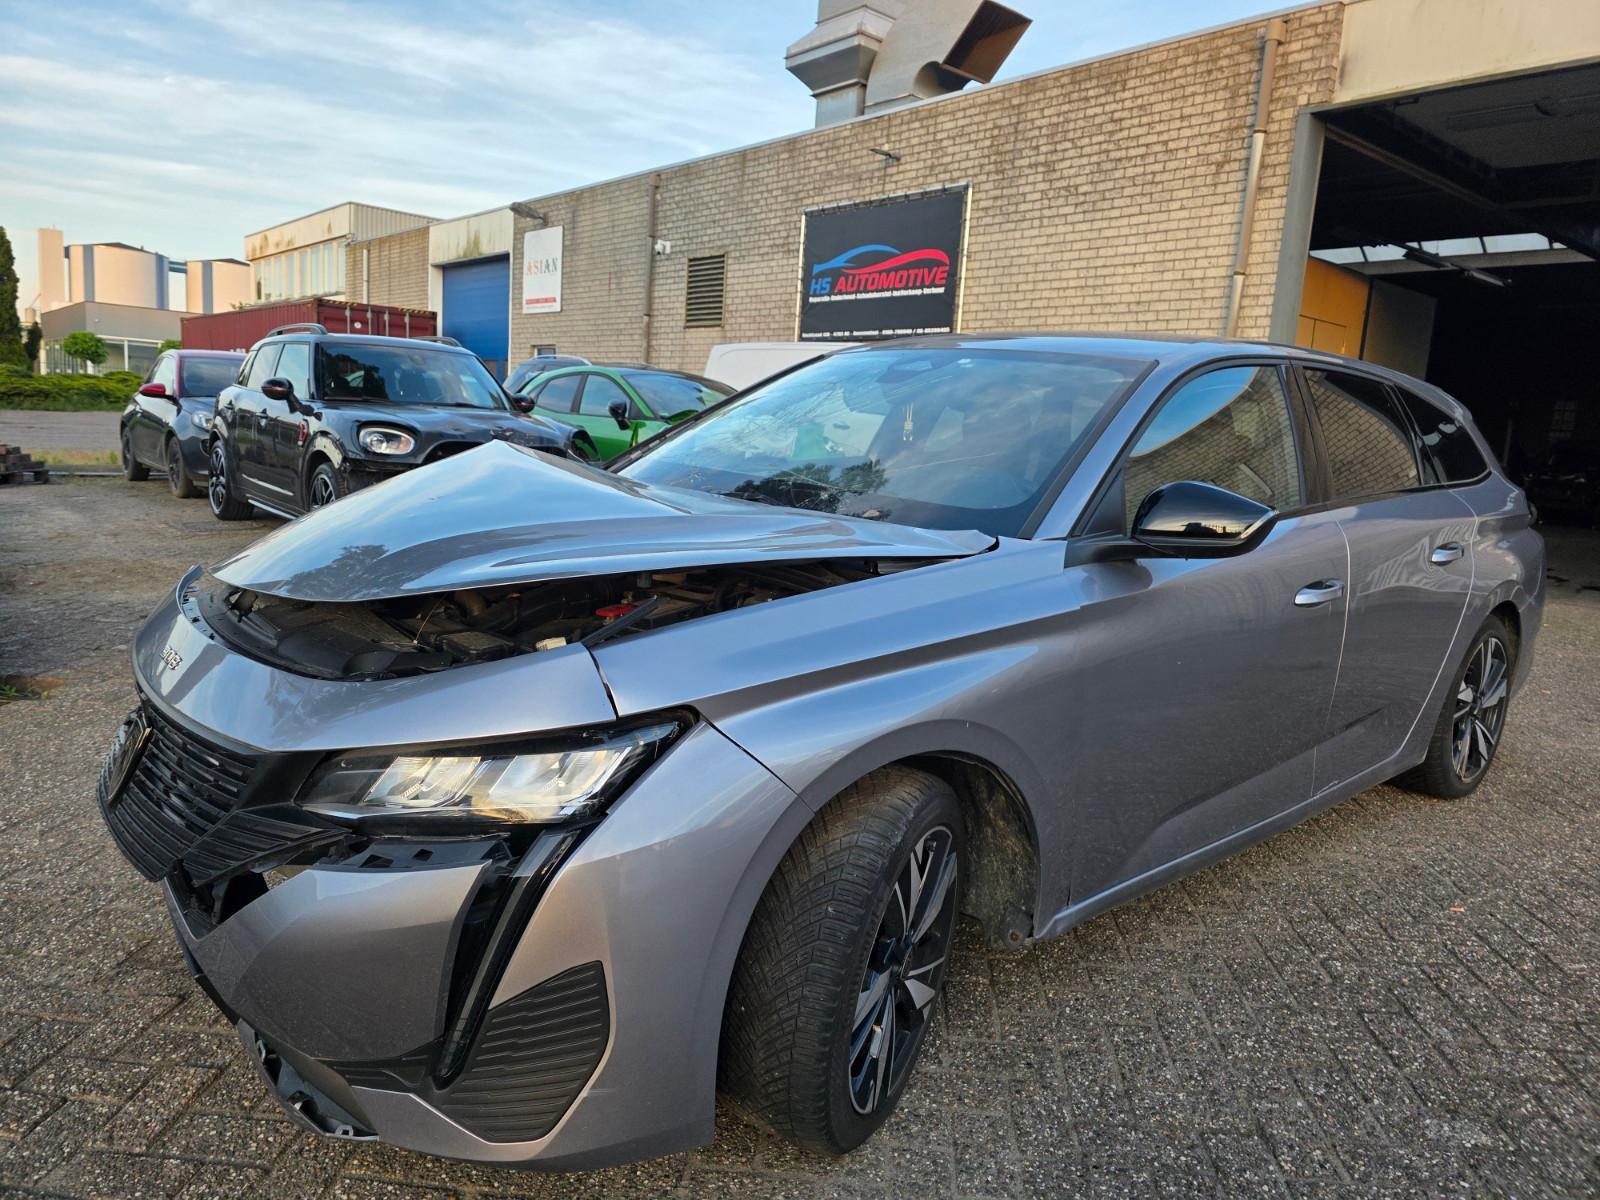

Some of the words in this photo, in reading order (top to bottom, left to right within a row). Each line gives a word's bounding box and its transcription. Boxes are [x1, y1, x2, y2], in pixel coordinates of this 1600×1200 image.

[527, 257, 558, 274] ASIAN
[809, 277, 832, 295] HS
[834, 266, 950, 293] AUTOMOTIVE
